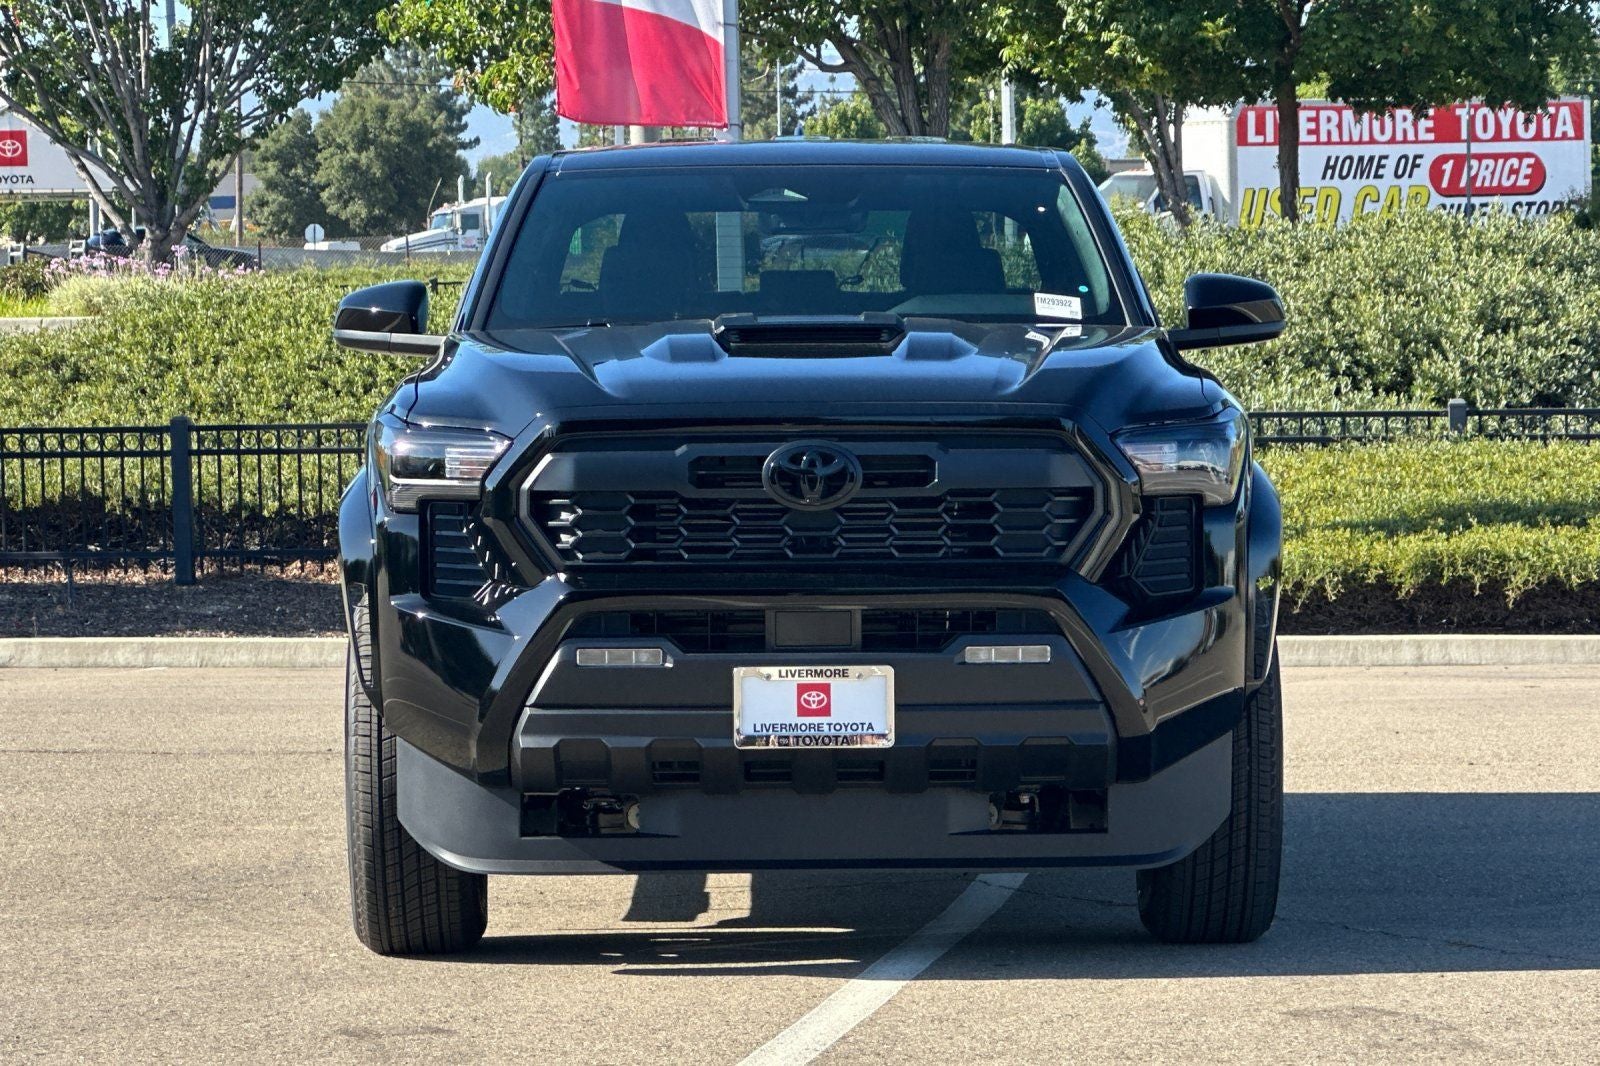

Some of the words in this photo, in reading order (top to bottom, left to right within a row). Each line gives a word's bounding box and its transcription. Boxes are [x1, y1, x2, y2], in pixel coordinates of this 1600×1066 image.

[1247, 106, 1435, 144] LIERMORE
[1455, 105, 1576, 141] TOYOTA
[1321, 154, 1390, 181] HOME
[1394, 153, 1425, 179] OF
[1441, 160, 1455, 189] 1
[1459, 157, 1536, 187] PRICE
[0, 174, 35, 184] YOTA
[778, 668, 850, 679] LIVERMORE
[753, 723, 825, 733] LIVERMORE
[827, 722, 875, 732] TOYOTA
[794, 735, 850, 746] TOYOTA
